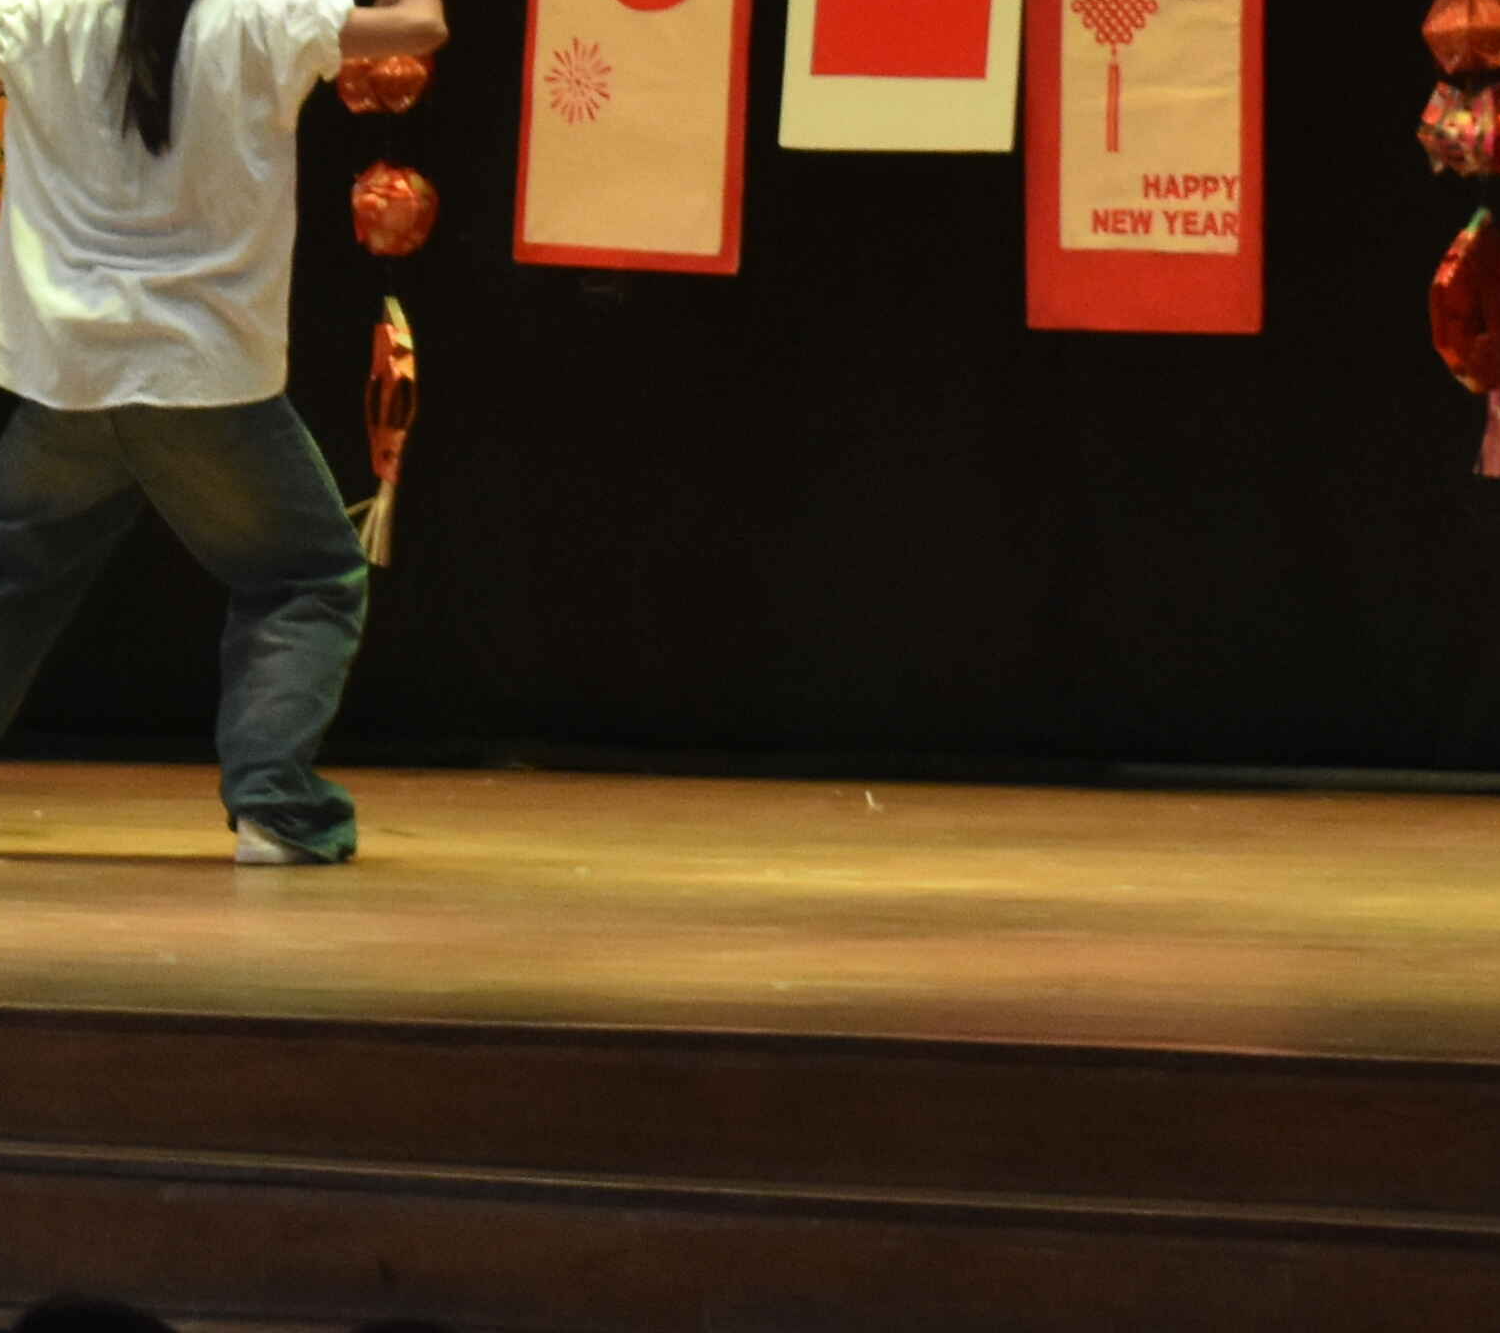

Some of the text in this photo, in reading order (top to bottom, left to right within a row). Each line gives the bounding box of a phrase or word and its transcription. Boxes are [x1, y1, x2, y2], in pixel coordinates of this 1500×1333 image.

[1142, 174, 1239, 201] HAPPY
[1091, 209, 1239, 236] NEW YEAR
